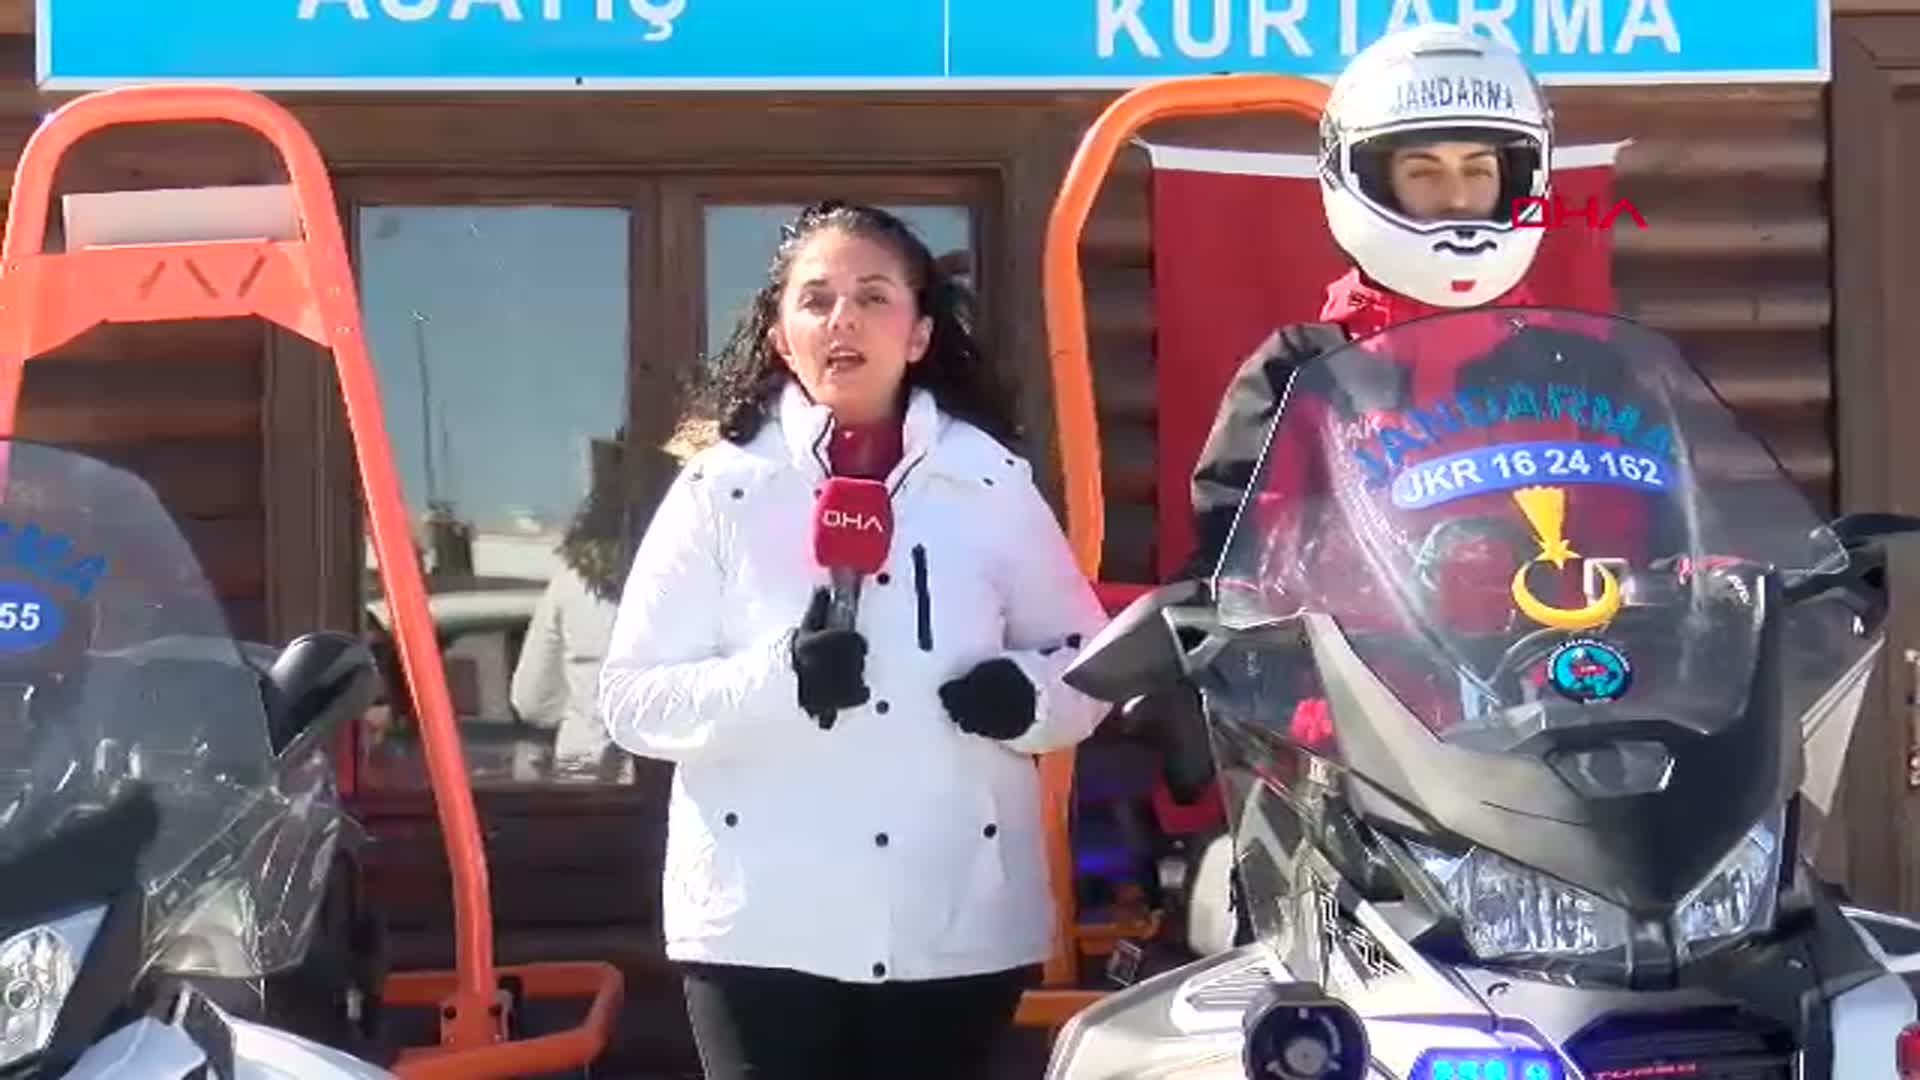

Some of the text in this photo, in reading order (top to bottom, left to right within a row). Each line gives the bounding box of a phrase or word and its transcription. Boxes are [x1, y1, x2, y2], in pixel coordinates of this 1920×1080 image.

[1352, 382, 1676, 484] JANDARMA
[1401, 449, 1663, 502] JKR 16 24 162
